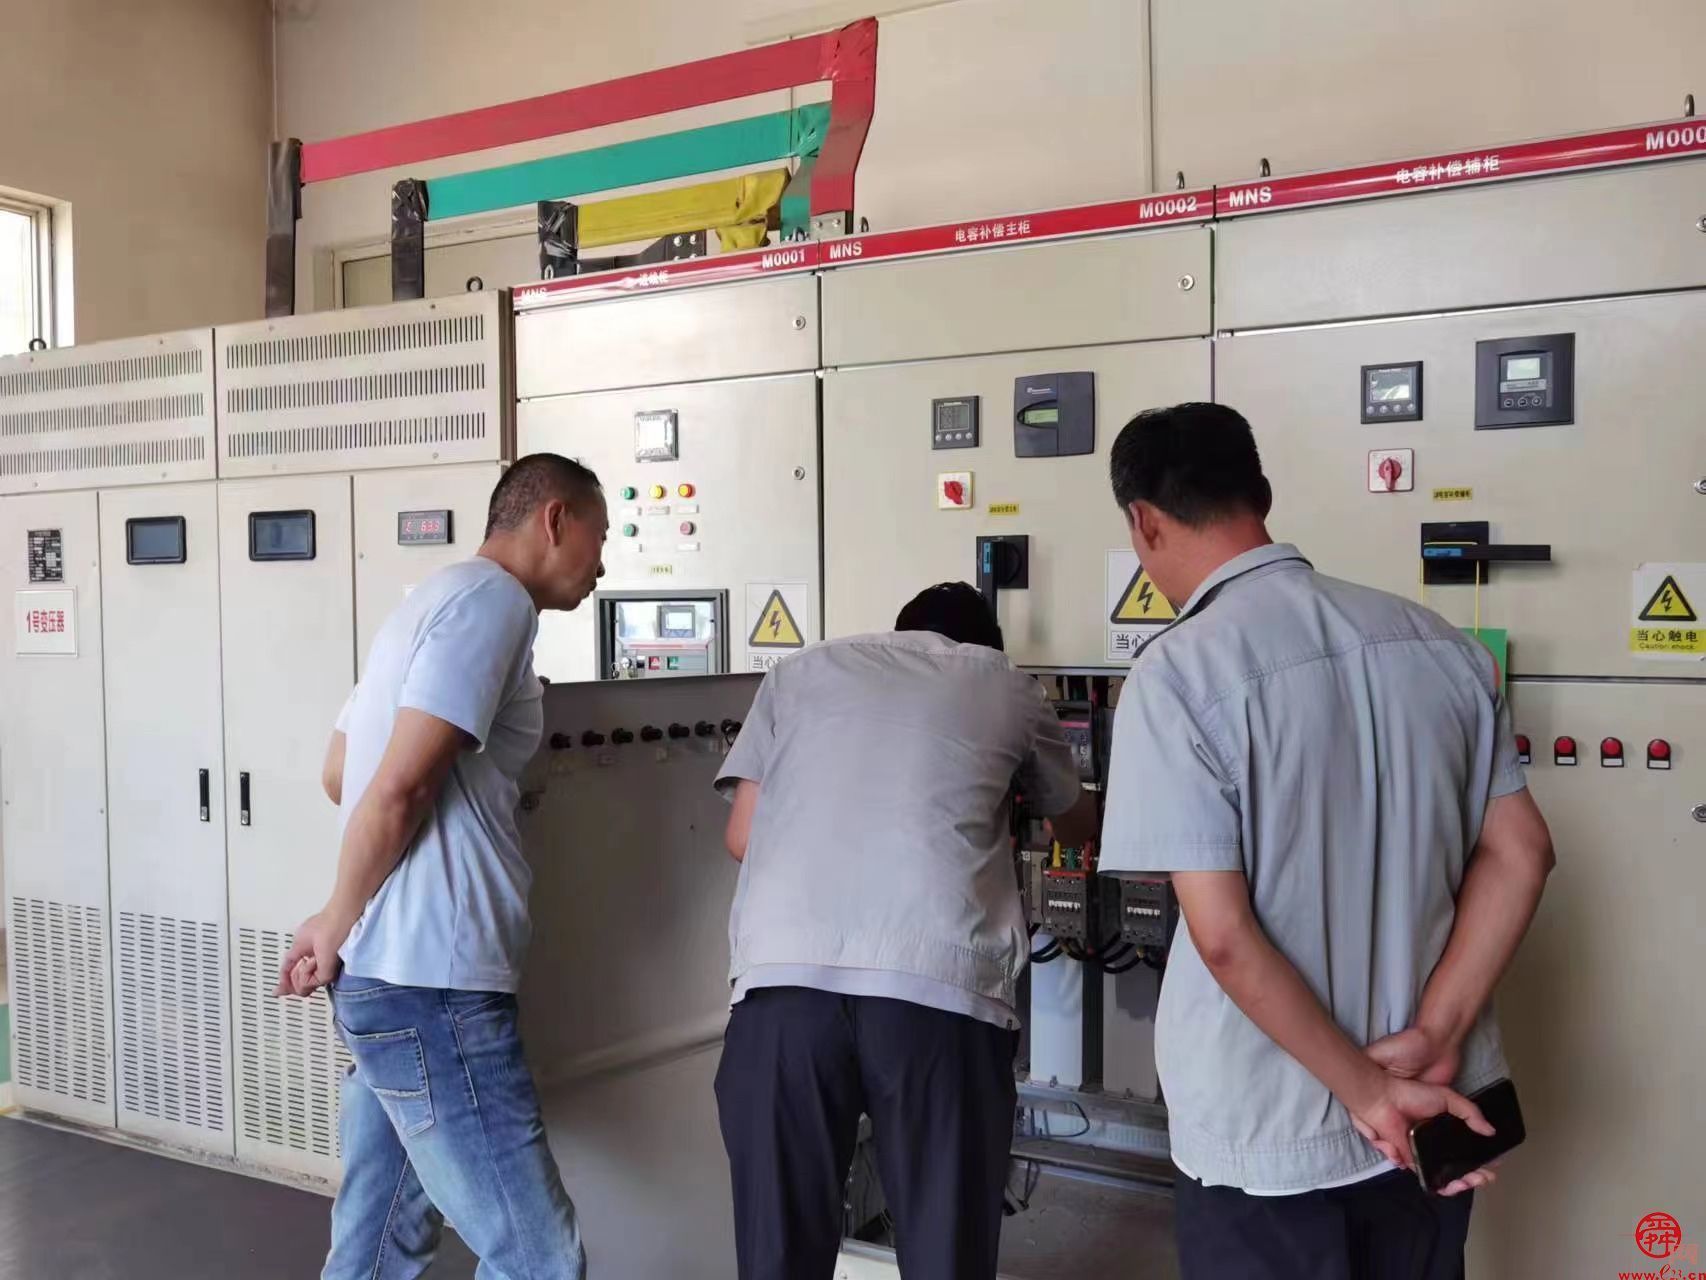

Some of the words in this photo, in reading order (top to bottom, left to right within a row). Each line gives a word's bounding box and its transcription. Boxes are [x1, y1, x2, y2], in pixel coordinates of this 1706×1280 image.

[1396, 155, 1500, 184] 电容补偿辅柜
[1139, 196, 1197, 218] M0002
[1229, 186, 1272, 207] MNS
[955, 220, 1031, 242] 电容补偿主柜
[762, 249, 805, 268] M0001
[829, 242, 862, 259] MNS
[27, 609, 65, 633] 1号变压器
[1637, 630, 1698, 642] 当心触电
